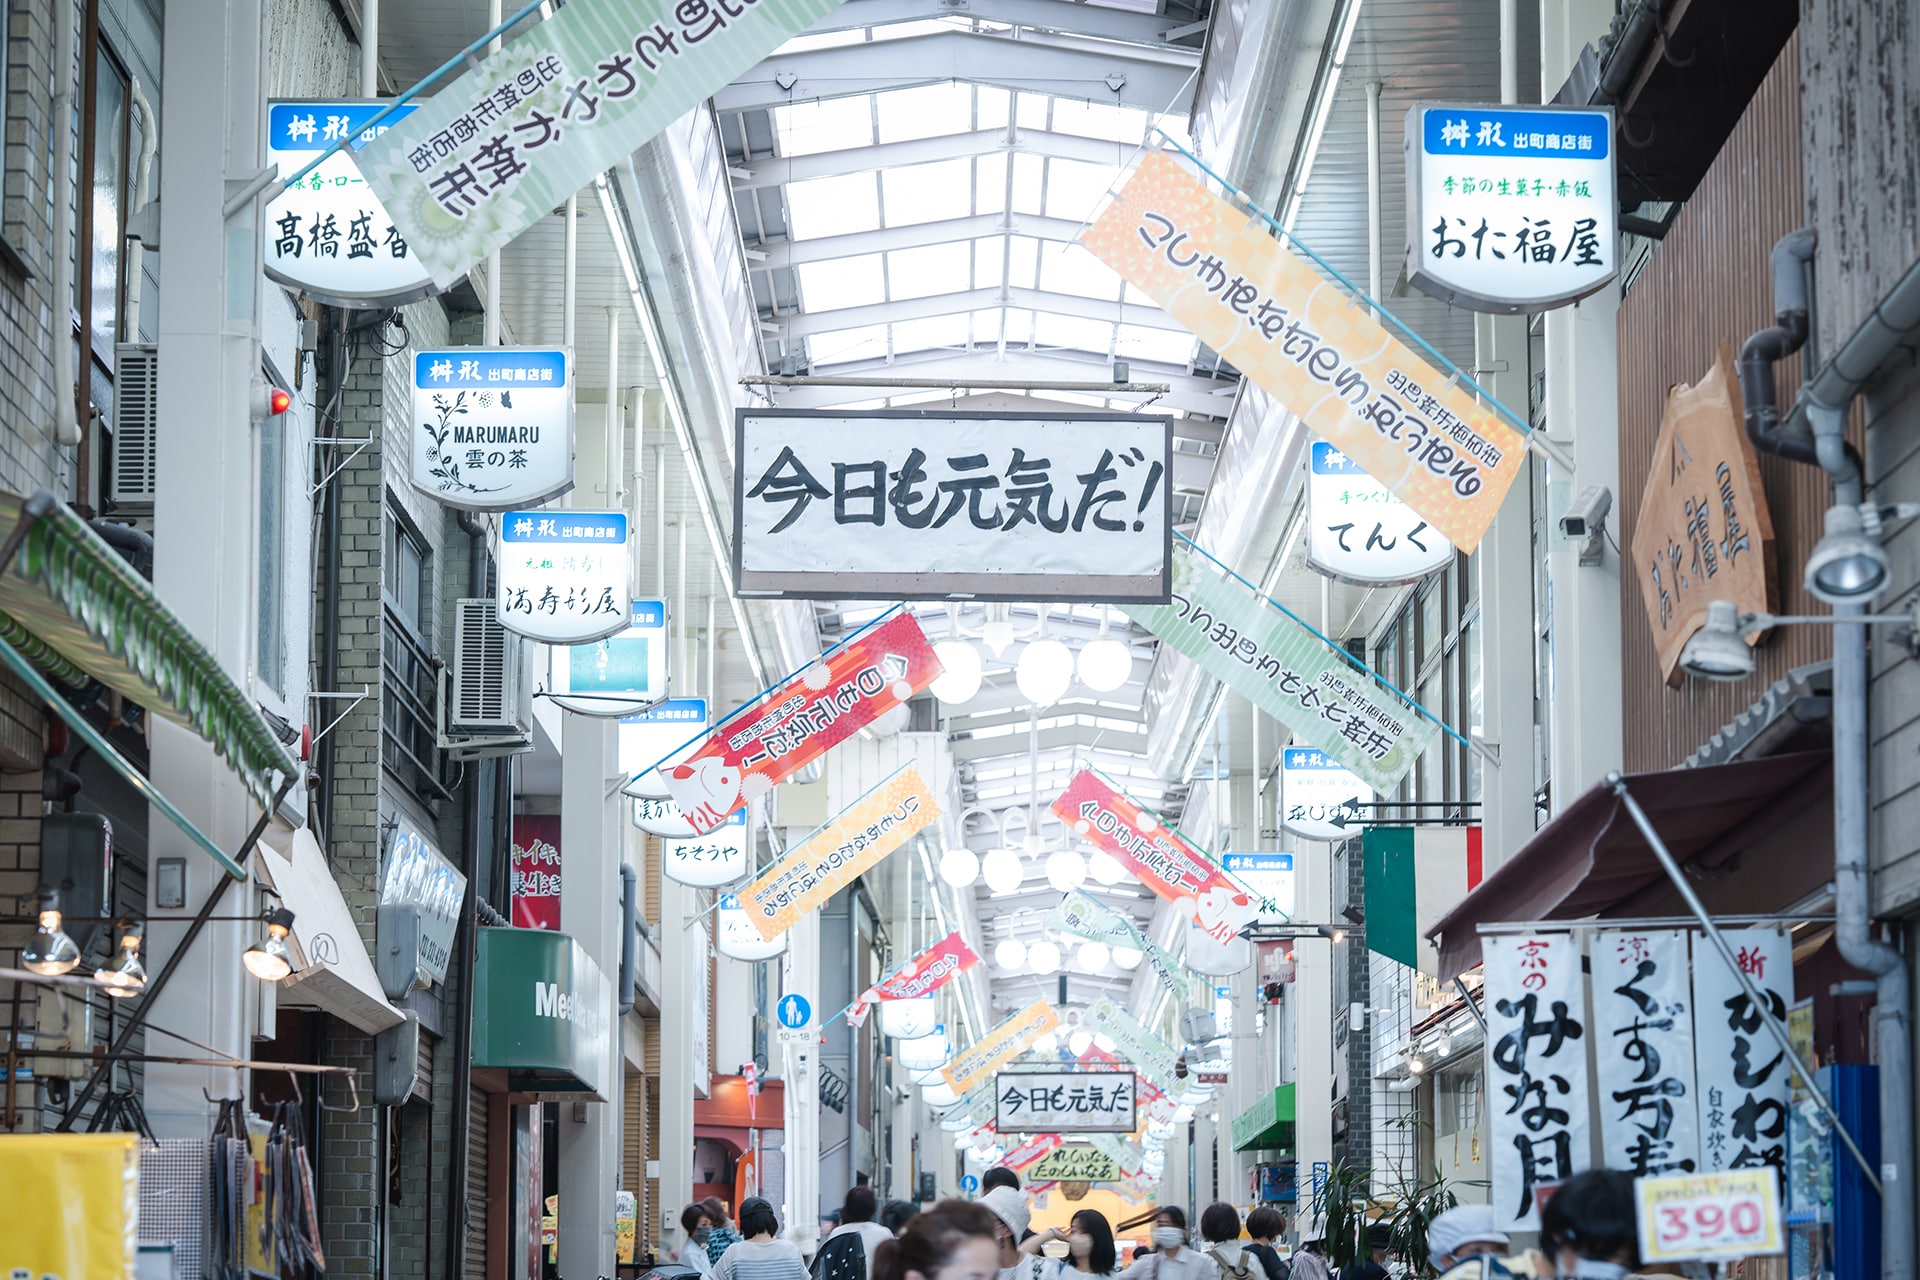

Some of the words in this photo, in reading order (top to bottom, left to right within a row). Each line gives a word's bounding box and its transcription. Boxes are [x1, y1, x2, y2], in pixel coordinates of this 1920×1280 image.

[407, 55, 564, 173] 出町桝形商店街
[287, 114, 350, 143] 桝形
[1440, 119, 1507, 148] 桝形
[1513, 133, 1593, 151] 出町商店街
[1442, 175, 1593, 198] 季節の生菓子・赤飯
[1431, 216, 1604, 267] おた福屋
[429, 359, 482, 383] 桝形
[488, 368, 552, 381] 出町商店街
[454, 426, 539, 444] MARUMARU
[465, 449, 528, 469] 雲の茶
[745, 445, 1164, 534] 今日も元気だ!
[513, 517, 558, 538] 桝形
[562, 526, 616, 538] 出町商店街
[674, 844, 738, 863] ちそうや
[1660, 1201, 1761, 1242] 390
